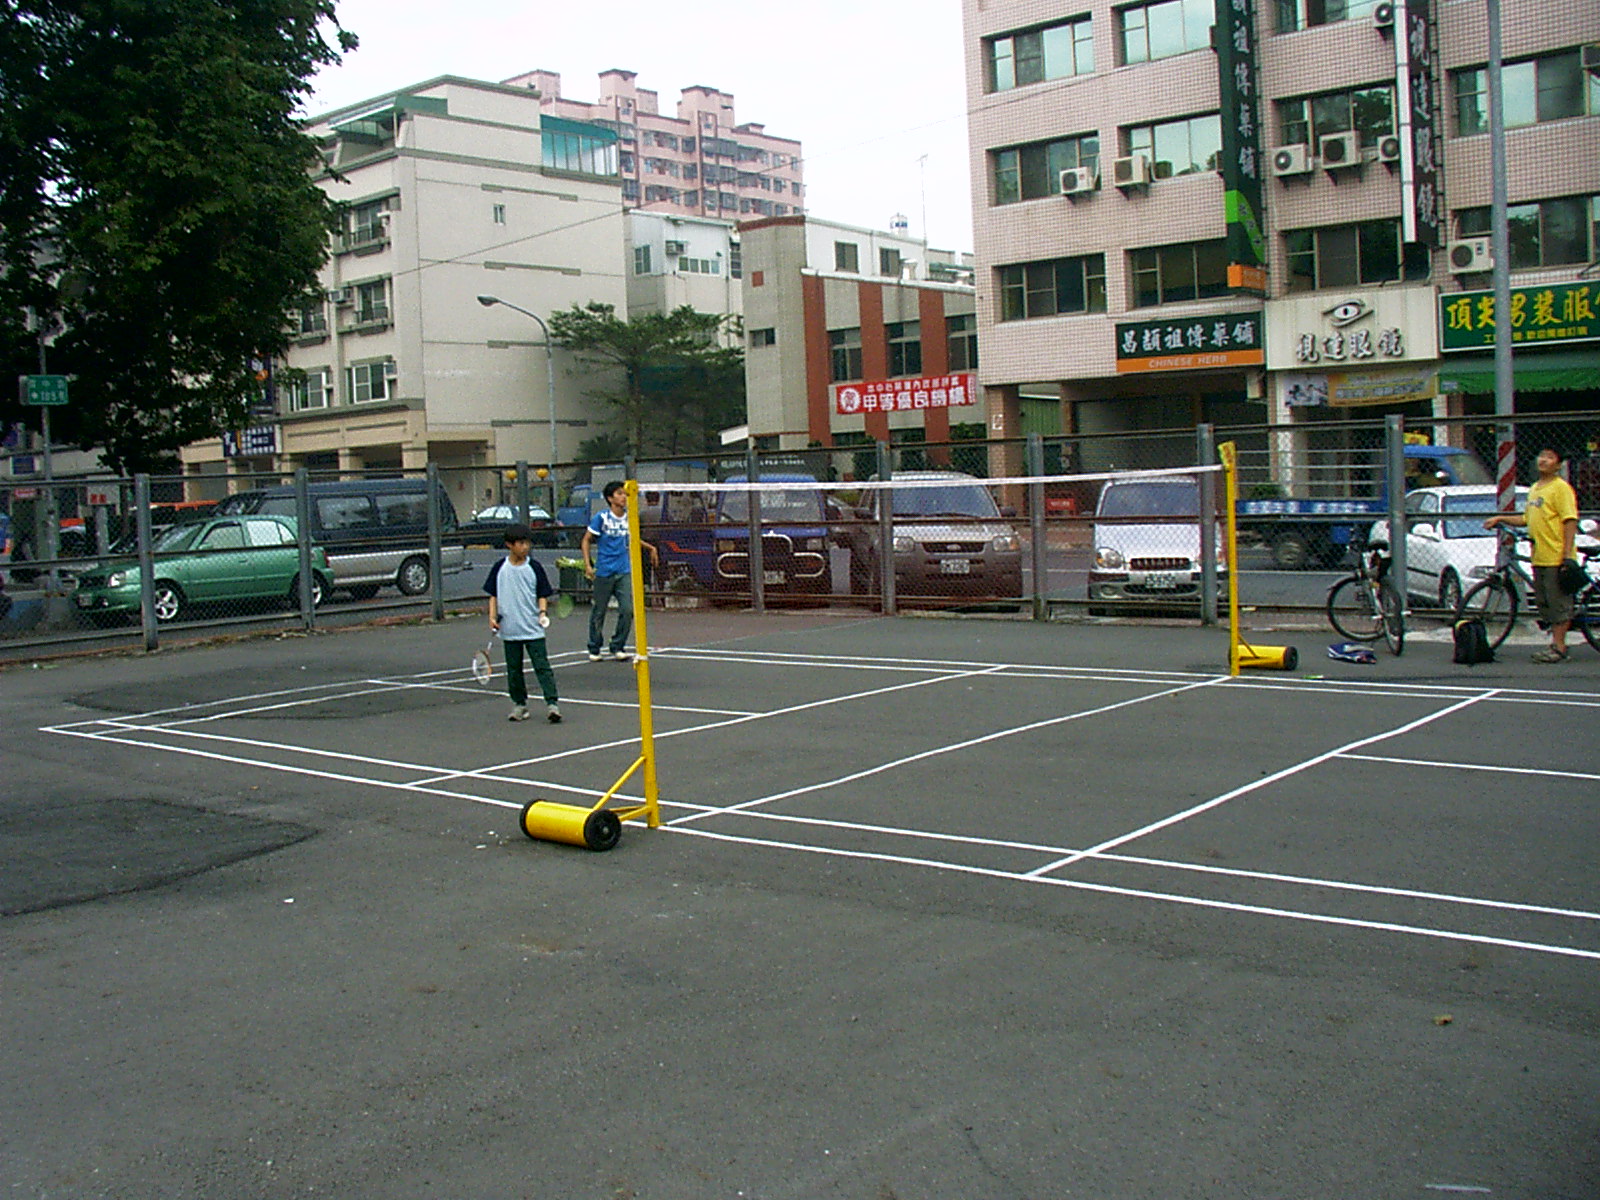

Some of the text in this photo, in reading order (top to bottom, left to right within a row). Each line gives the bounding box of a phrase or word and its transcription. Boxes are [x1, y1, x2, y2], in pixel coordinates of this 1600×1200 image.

[1447, 287, 1600, 331] 頂尖男裝服
[1149, 354, 1228, 369] CHINESE HERB
[863, 386, 965, 412] 甲等優良機構
